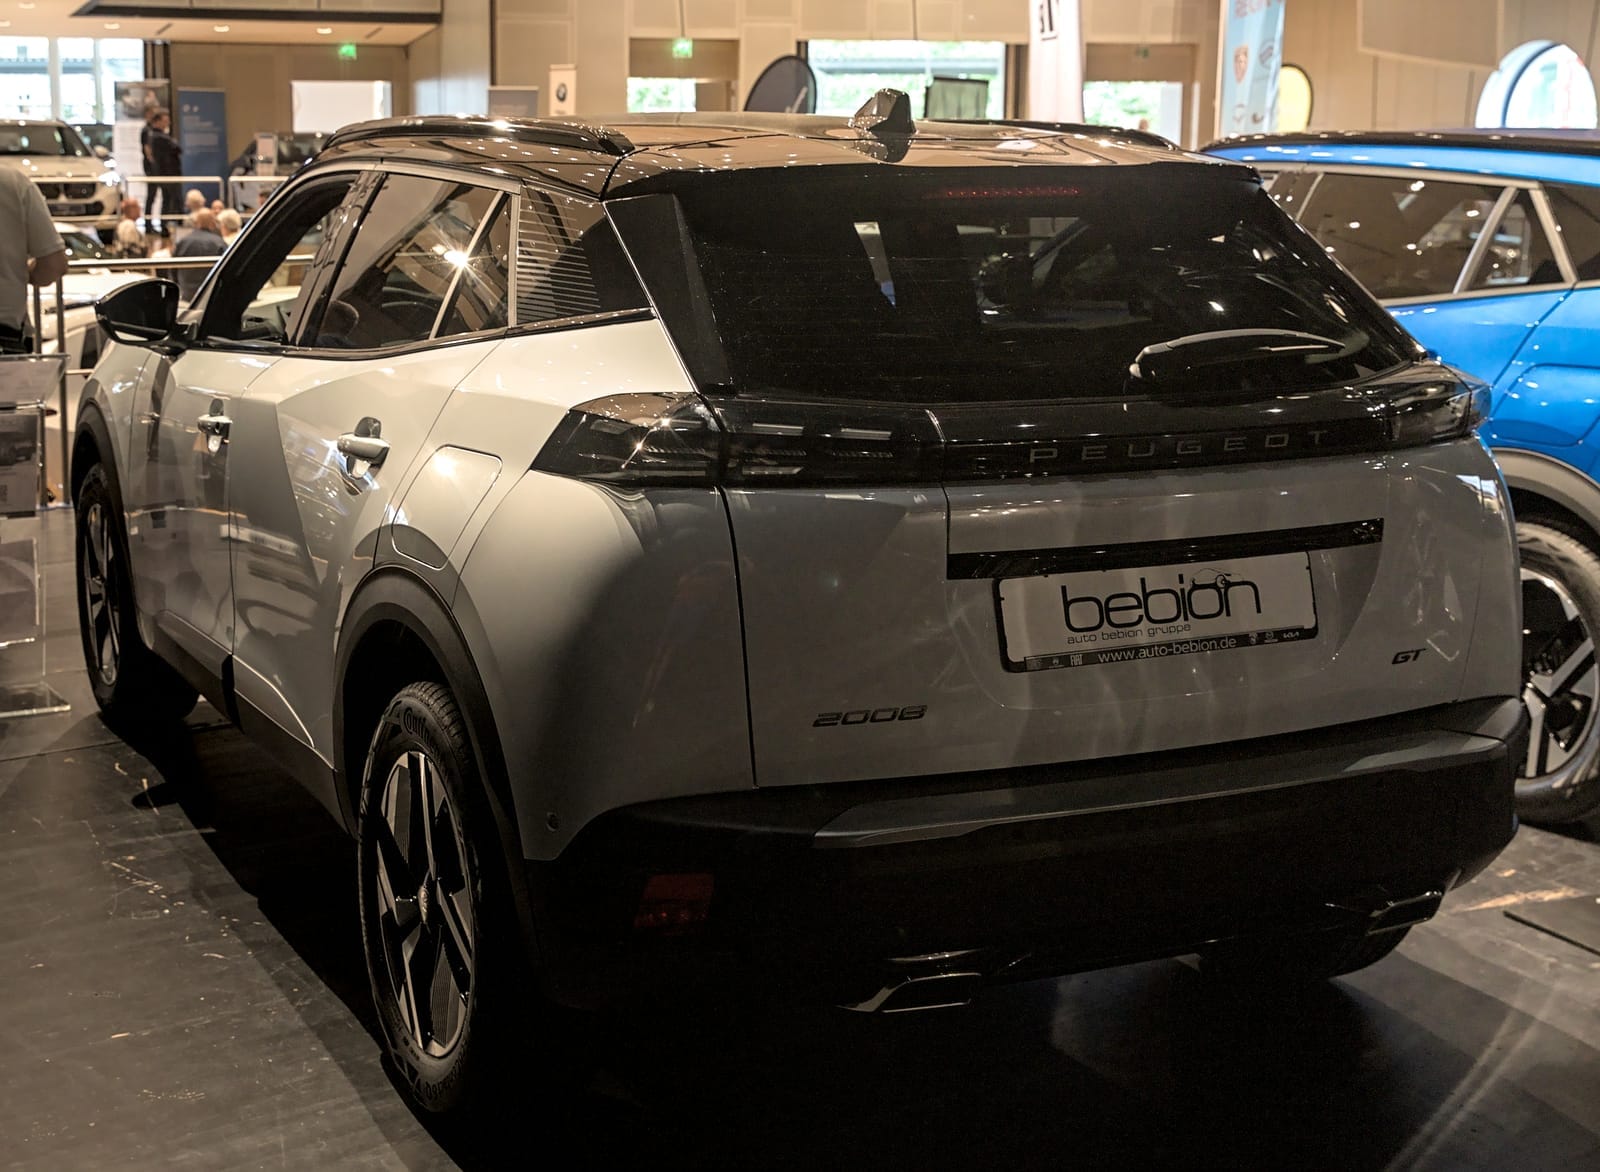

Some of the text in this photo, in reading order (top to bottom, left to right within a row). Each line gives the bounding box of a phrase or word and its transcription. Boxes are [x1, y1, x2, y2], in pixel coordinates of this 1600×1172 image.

[1029, 430, 1328, 463] PEUGEOT
[1061, 574, 1262, 633] bebion
[1067, 623, 1191, 645] auto bebion gruppe
[1098, 635, 1237, 663] www.auto-bebion.de
[1391, 648, 1426, 665] GT
[812, 705, 928, 727] 2008
